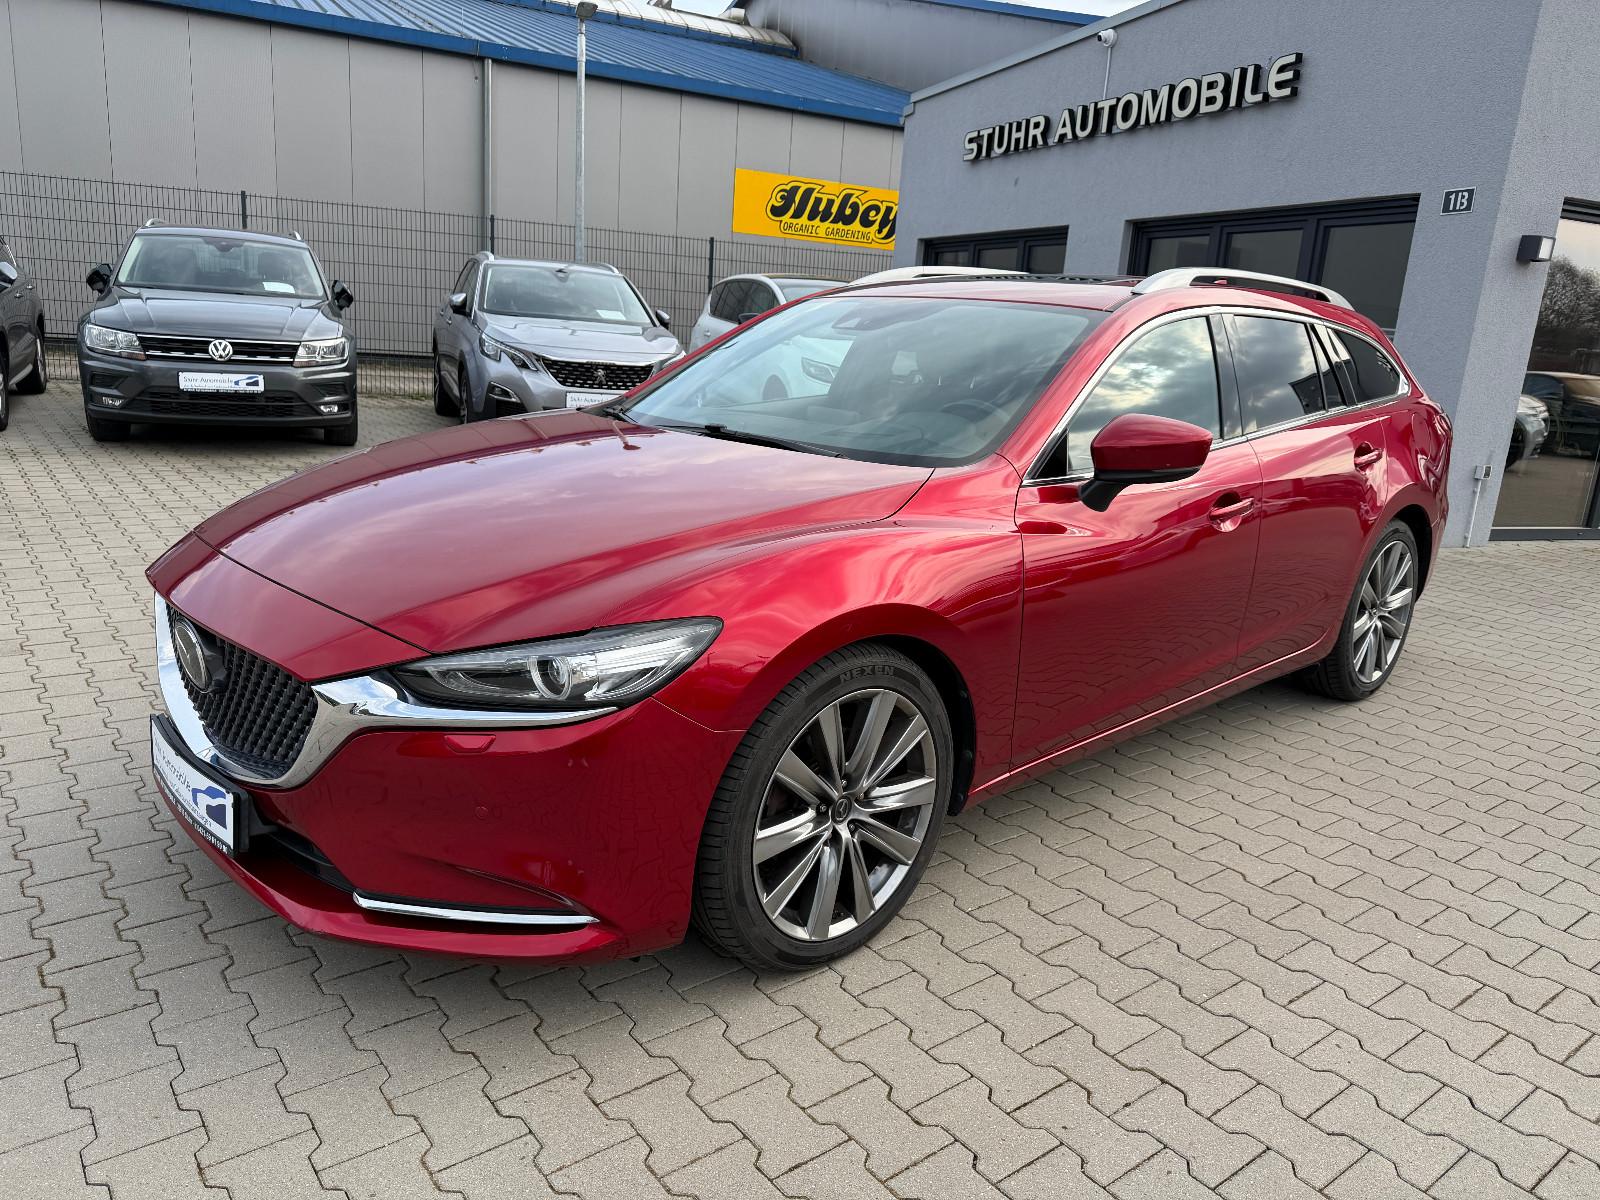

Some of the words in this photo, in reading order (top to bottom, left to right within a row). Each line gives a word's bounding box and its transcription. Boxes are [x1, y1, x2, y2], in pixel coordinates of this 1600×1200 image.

[963, 115, 1049, 161] STUHR
[1054, 53, 1301, 143] AUTOMOBILE
[1449, 191, 1469, 211] 1B
[782, 221, 820, 235] ORGANIC
[825, 226, 871, 242] GARDENING
[209, 340, 233, 360] VW
[840, 664, 895, 682] NEXEN
